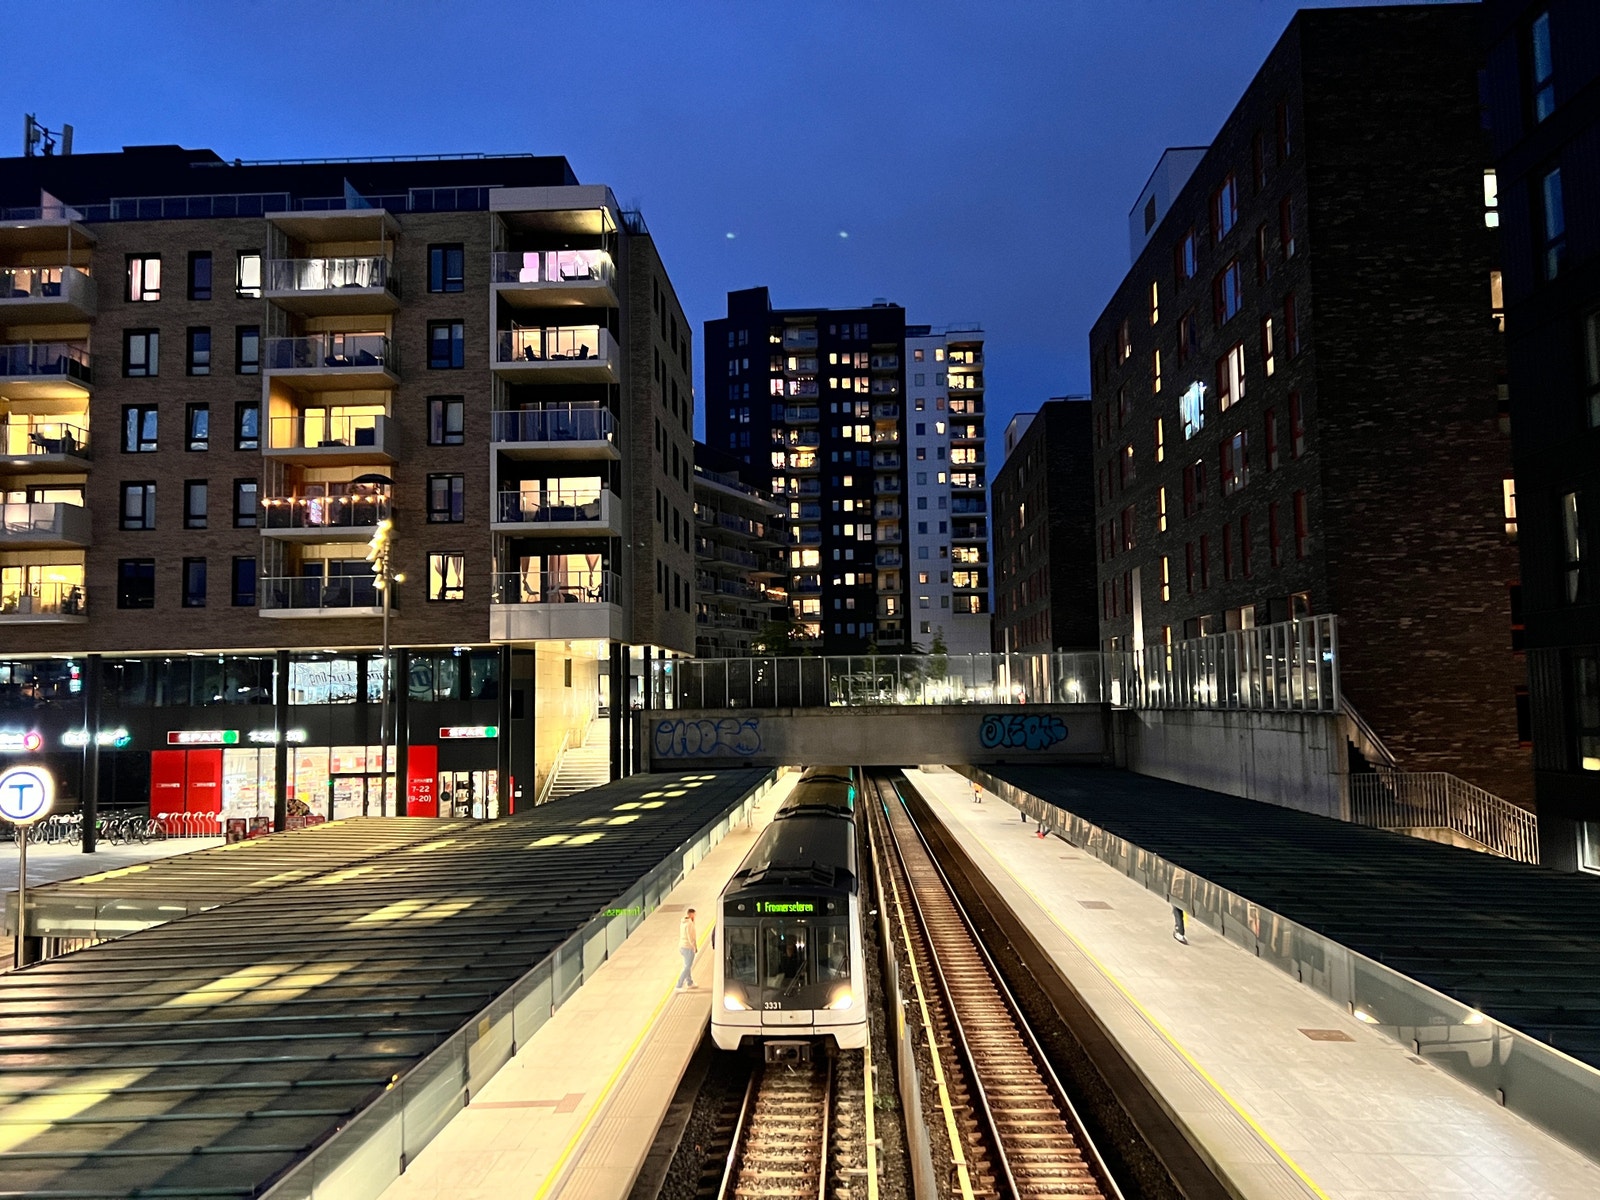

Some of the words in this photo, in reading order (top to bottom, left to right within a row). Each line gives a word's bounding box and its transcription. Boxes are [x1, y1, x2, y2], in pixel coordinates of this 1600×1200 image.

[178, 732, 222, 742] SPAR
[411, 785, 430, 793] 7-22
[9, 784, 33, 810] T
[408, 794, 432, 803] (9-20)
[756, 901, 761, 912] 1
[764, 1001, 782, 1010] 3331
